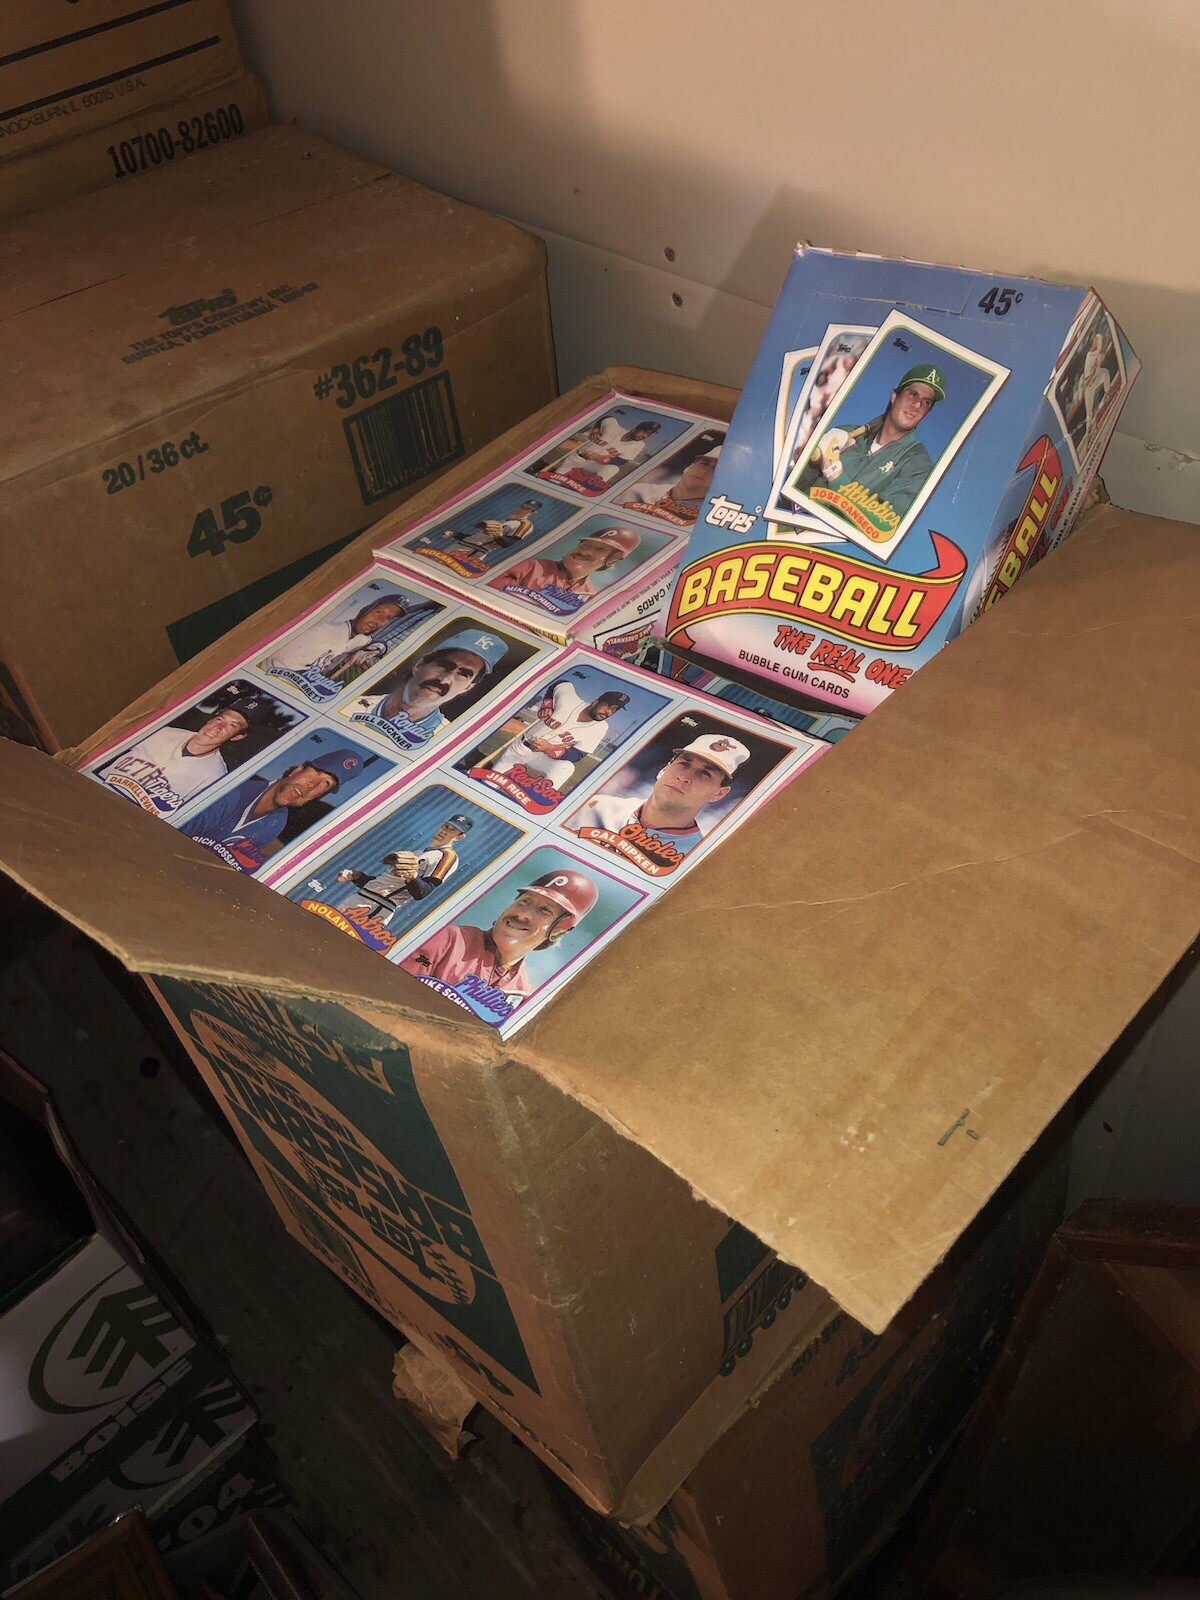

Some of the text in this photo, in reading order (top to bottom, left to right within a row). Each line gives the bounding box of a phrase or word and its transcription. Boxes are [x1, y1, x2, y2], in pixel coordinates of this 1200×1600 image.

[107, 103, 245, 179] 10700-82600
[313, 326, 445, 409] #362-89
[565, 479, 586, 492] RICE
[837, 481, 902, 527] Athletics
[654, 507, 687, 526] RIPKEN
[812, 489, 880, 540] JOSE CANSECO
[422, 548, 472, 578] NOLAN RYAN
[505, 585, 561, 613] MIKE SCHMIDT
[637, 588, 666, 614] CARDS
[677, 552, 928, 639] BASEBALL
[773, 624, 816, 655] THE
[810, 639, 866, 675] REAL
[270, 668, 325, 702] GEORGE BRETT
[303, 666, 345, 693] Royals
[738, 649, 851, 699] BUBBLE GUM CARDS
[354, 714, 412, 750] BILL BUCKNER
[391, 710, 435, 739] Royals
[110, 776, 160, 817] DARRELL EVANS
[151, 775, 185, 808] Tigers
[486, 771, 531, 805] JIM RICE
[509, 764, 566, 805] Red Sox
[590, 829, 617, 843] CAL
[617, 839, 660, 875] RIPKEN
[619, 824, 685, 864] Orioles
[308, 902, 349, 931] NOLAN
[347, 906, 398, 946] Astros
[460, 973, 514, 1016] Phillies
[190, 1037, 498, 1278] BASEBALL
[50, 1356, 193, 1482] BOISE
